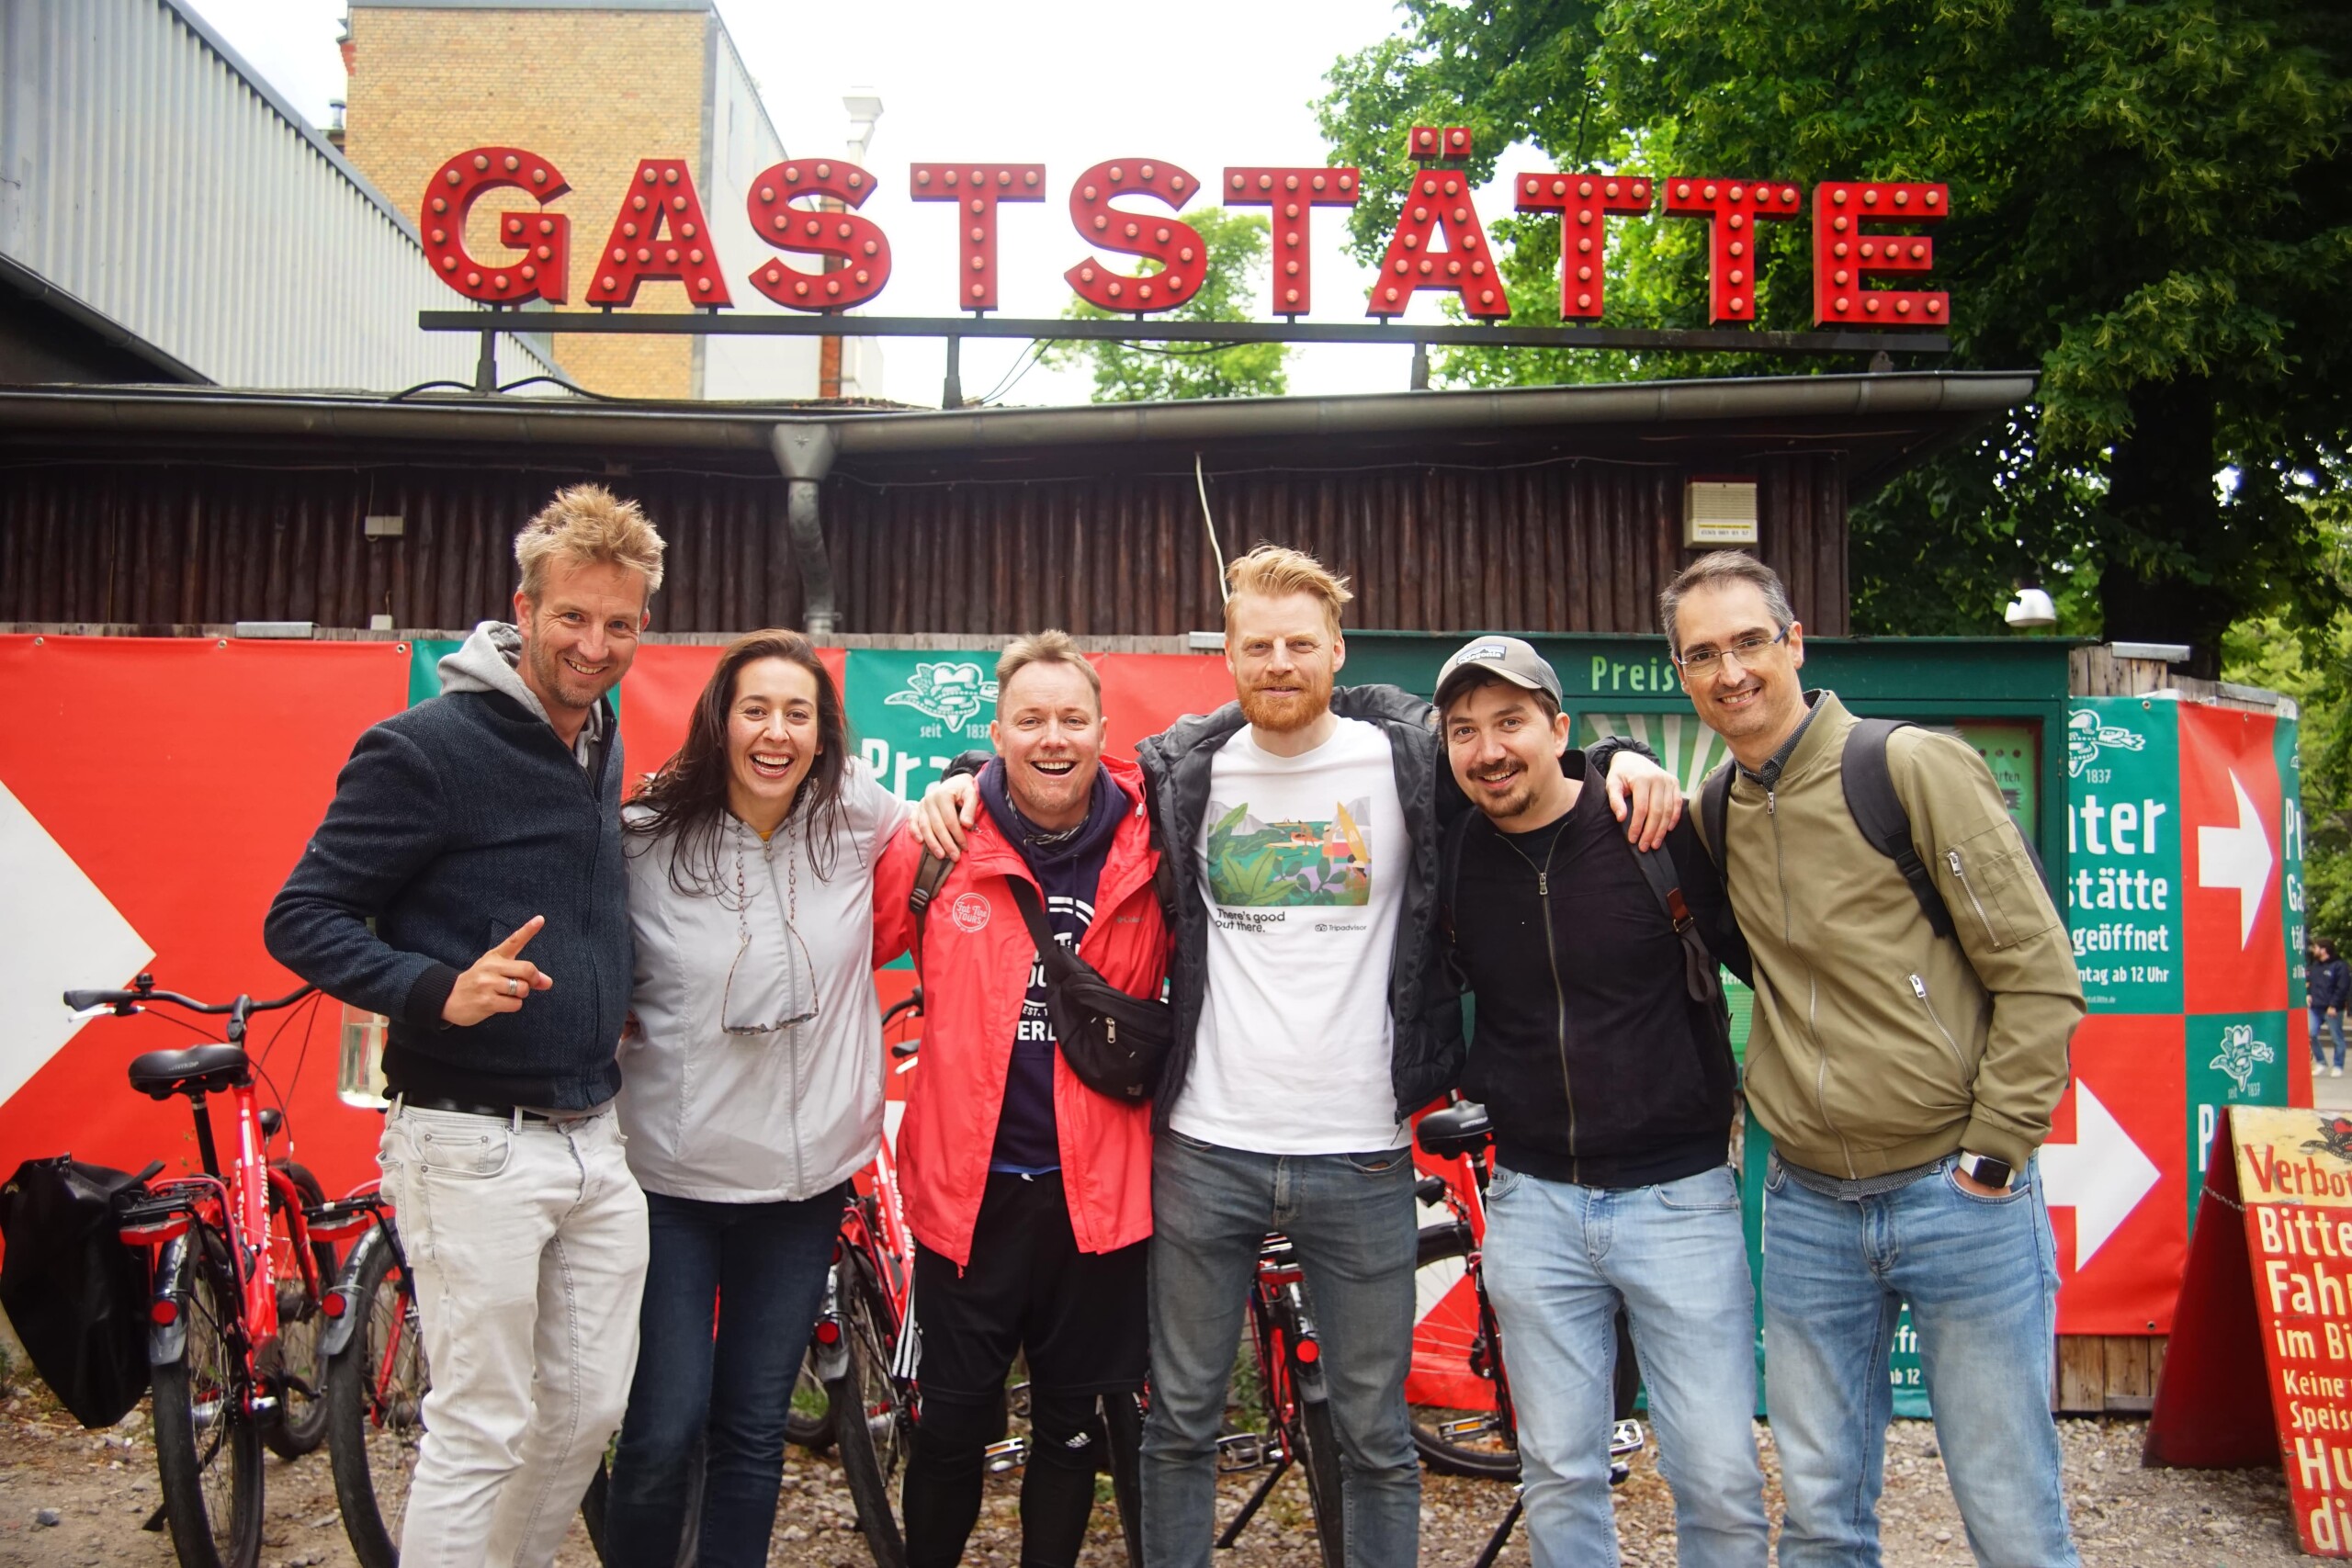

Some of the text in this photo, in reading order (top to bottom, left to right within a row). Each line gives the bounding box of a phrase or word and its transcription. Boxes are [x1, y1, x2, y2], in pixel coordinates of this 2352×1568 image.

[421, 127, 1949, 328] GASTSTÄTTE
[1591, 656, 1675, 692] Preis
[920, 724, 990, 739] seit 1837
[2086, 769, 2111, 784] 1837
[958, 911, 982, 925] TOURS
[1216, 908, 1285, 923] There's good
[1215, 920, 1266, 933] out there.
[1329, 924, 1367, 932] Tripadvisor
[2073, 923, 2169, 956] geöffnet
[2112, 966, 2127, 983] ab
[2131, 966, 2144, 983] 12
[2147, 966, 2169, 983] Uhr
[2247, 1082, 2261, 1098] 1837
[2257, 1205, 2352, 1258] Bitte
[2274, 1319, 2316, 1359] im
[1906, 1368, 1921, 1385] 12
[2283, 1369, 2345, 1397] Keine
[2290, 1401, 2352, 1433] Speis
